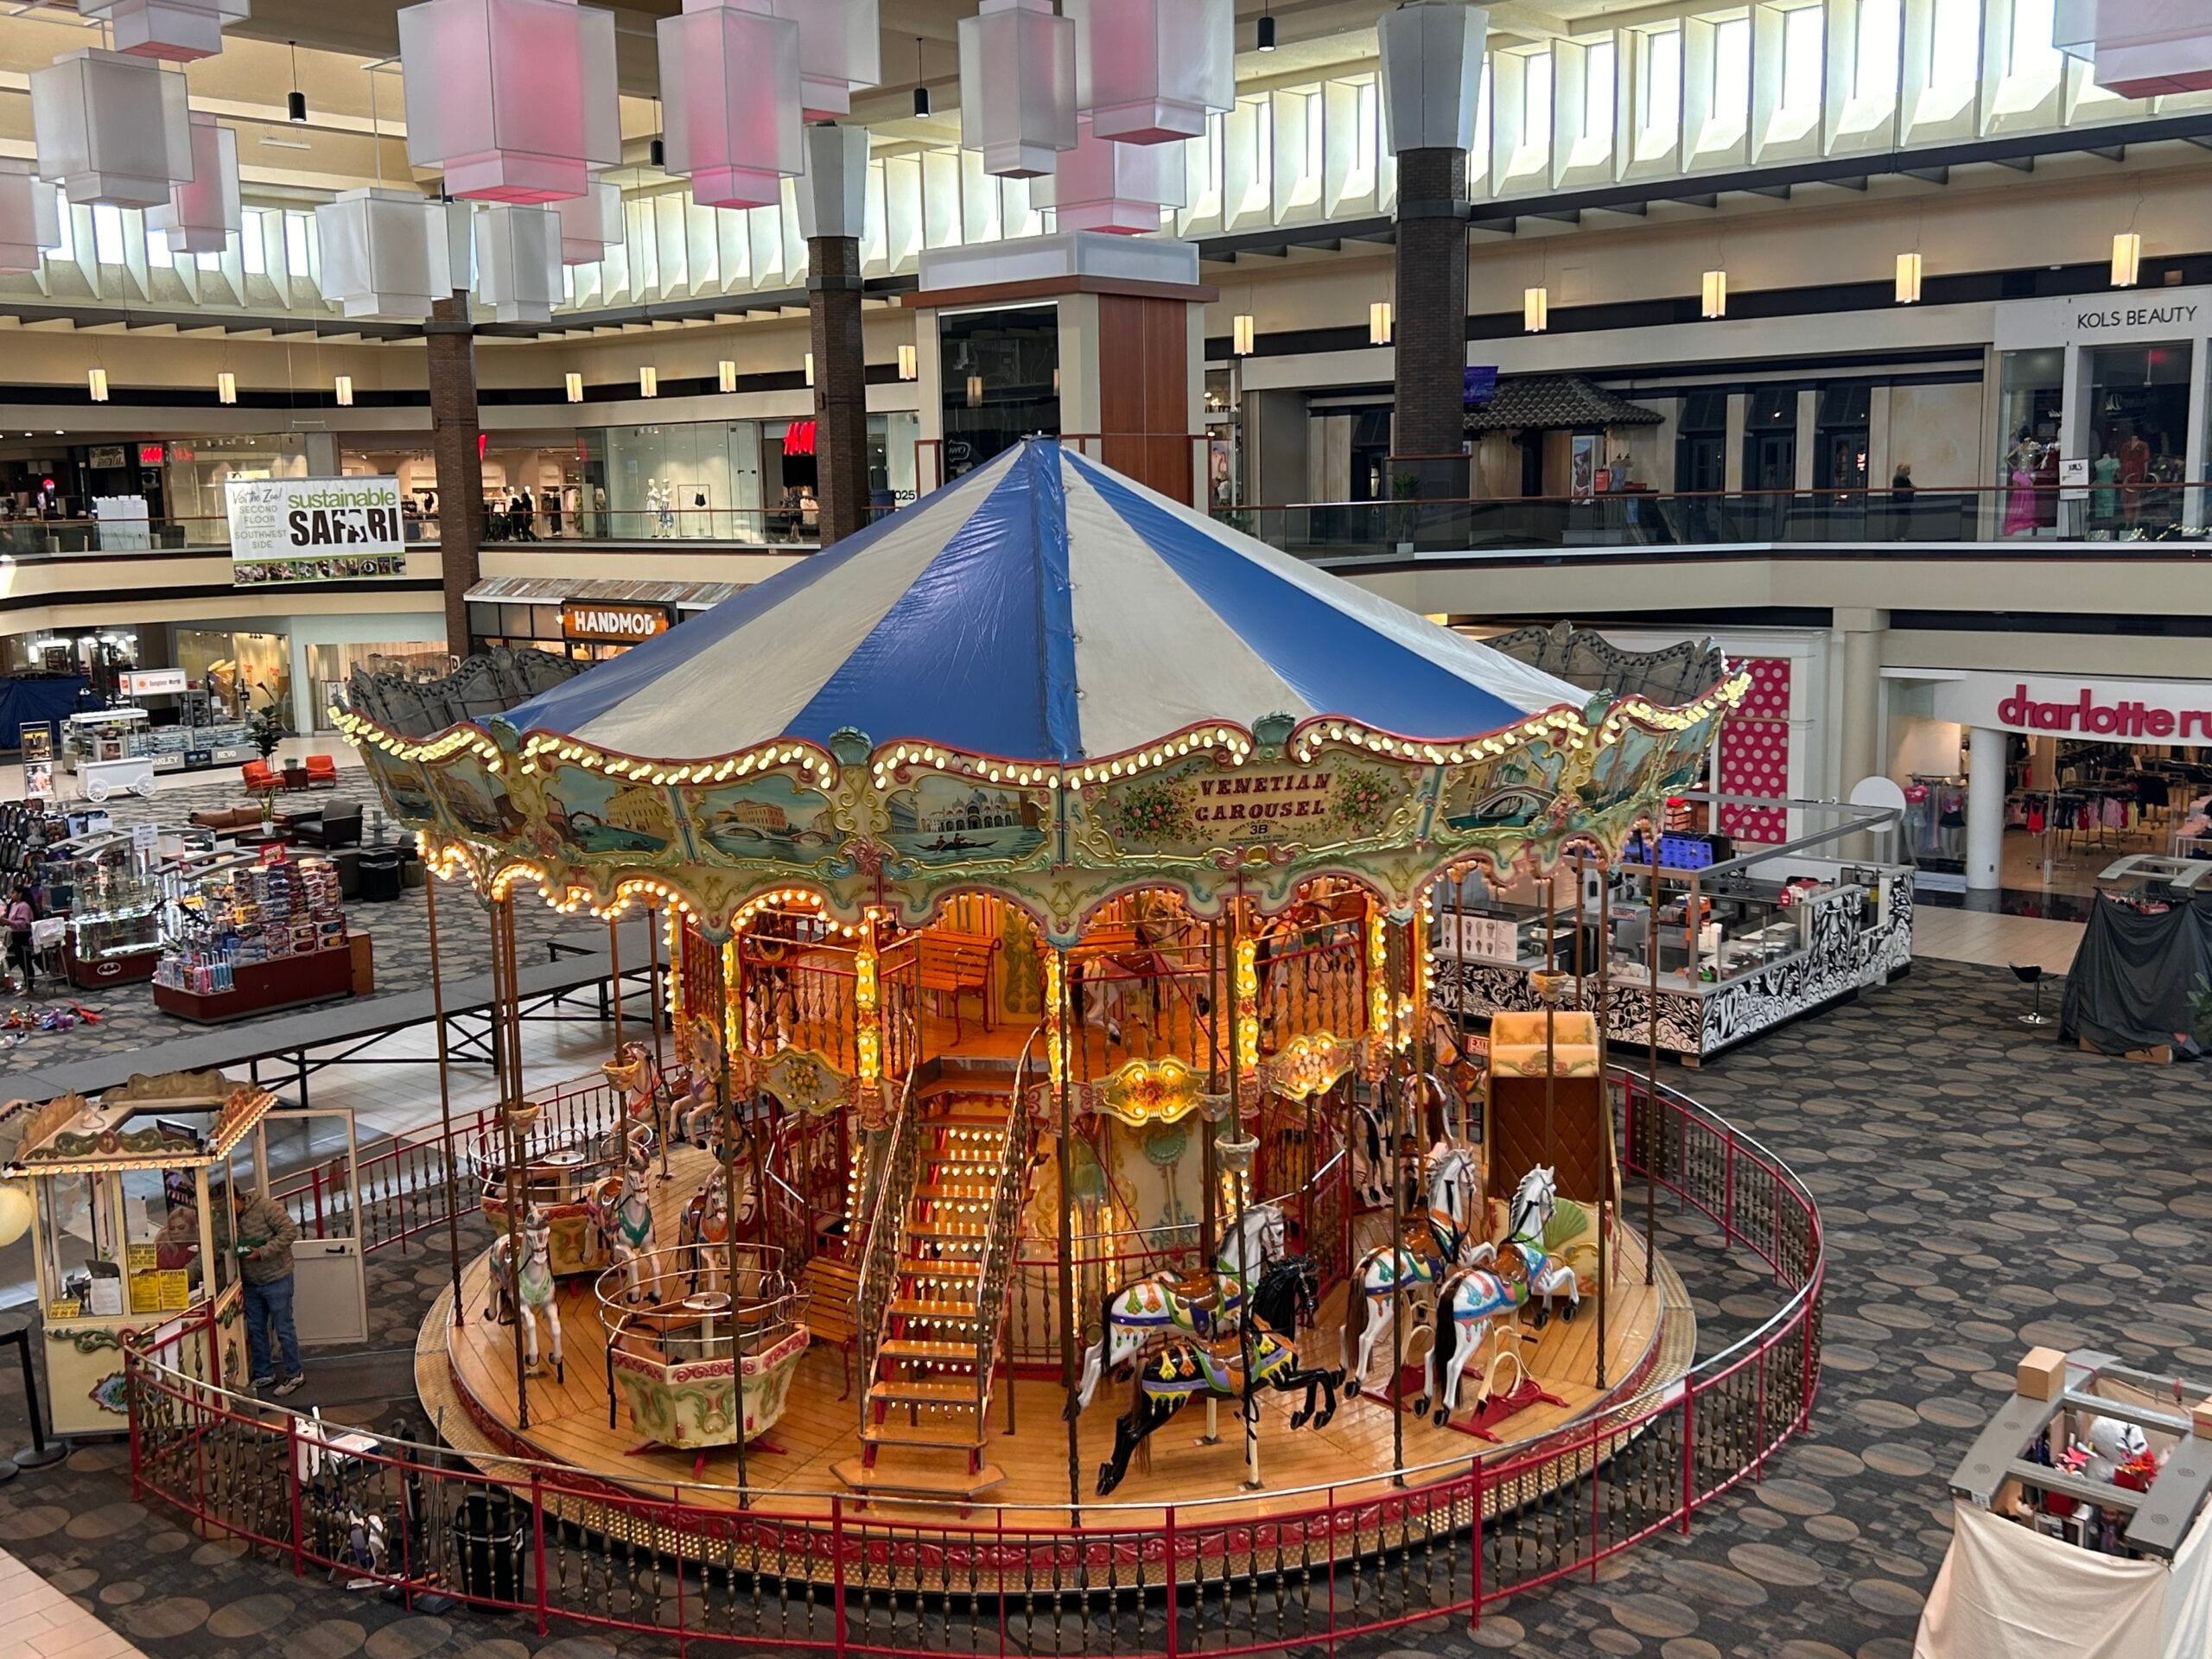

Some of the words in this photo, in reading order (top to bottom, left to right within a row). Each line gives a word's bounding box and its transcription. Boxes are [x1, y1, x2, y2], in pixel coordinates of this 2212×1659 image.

[2077, 311, 2120, 329] KOLS
[2126, 306, 2197, 326] BEAUTY
[288, 487, 397, 509] sustainable
[238, 505, 278, 514] SECOND
[244, 515, 276, 524] FLOOR
[234, 530, 287, 540] SOUTHWEST
[289, 508, 399, 547] SAFARI
[251, 540, 273, 550] SIDE
[1998, 684, 2175, 737] charlotte
[1198, 772, 1332, 797] VENETIAN
[1194, 799, 1325, 822] CAROUSEL
[1249, 824, 1268, 836] 3B
